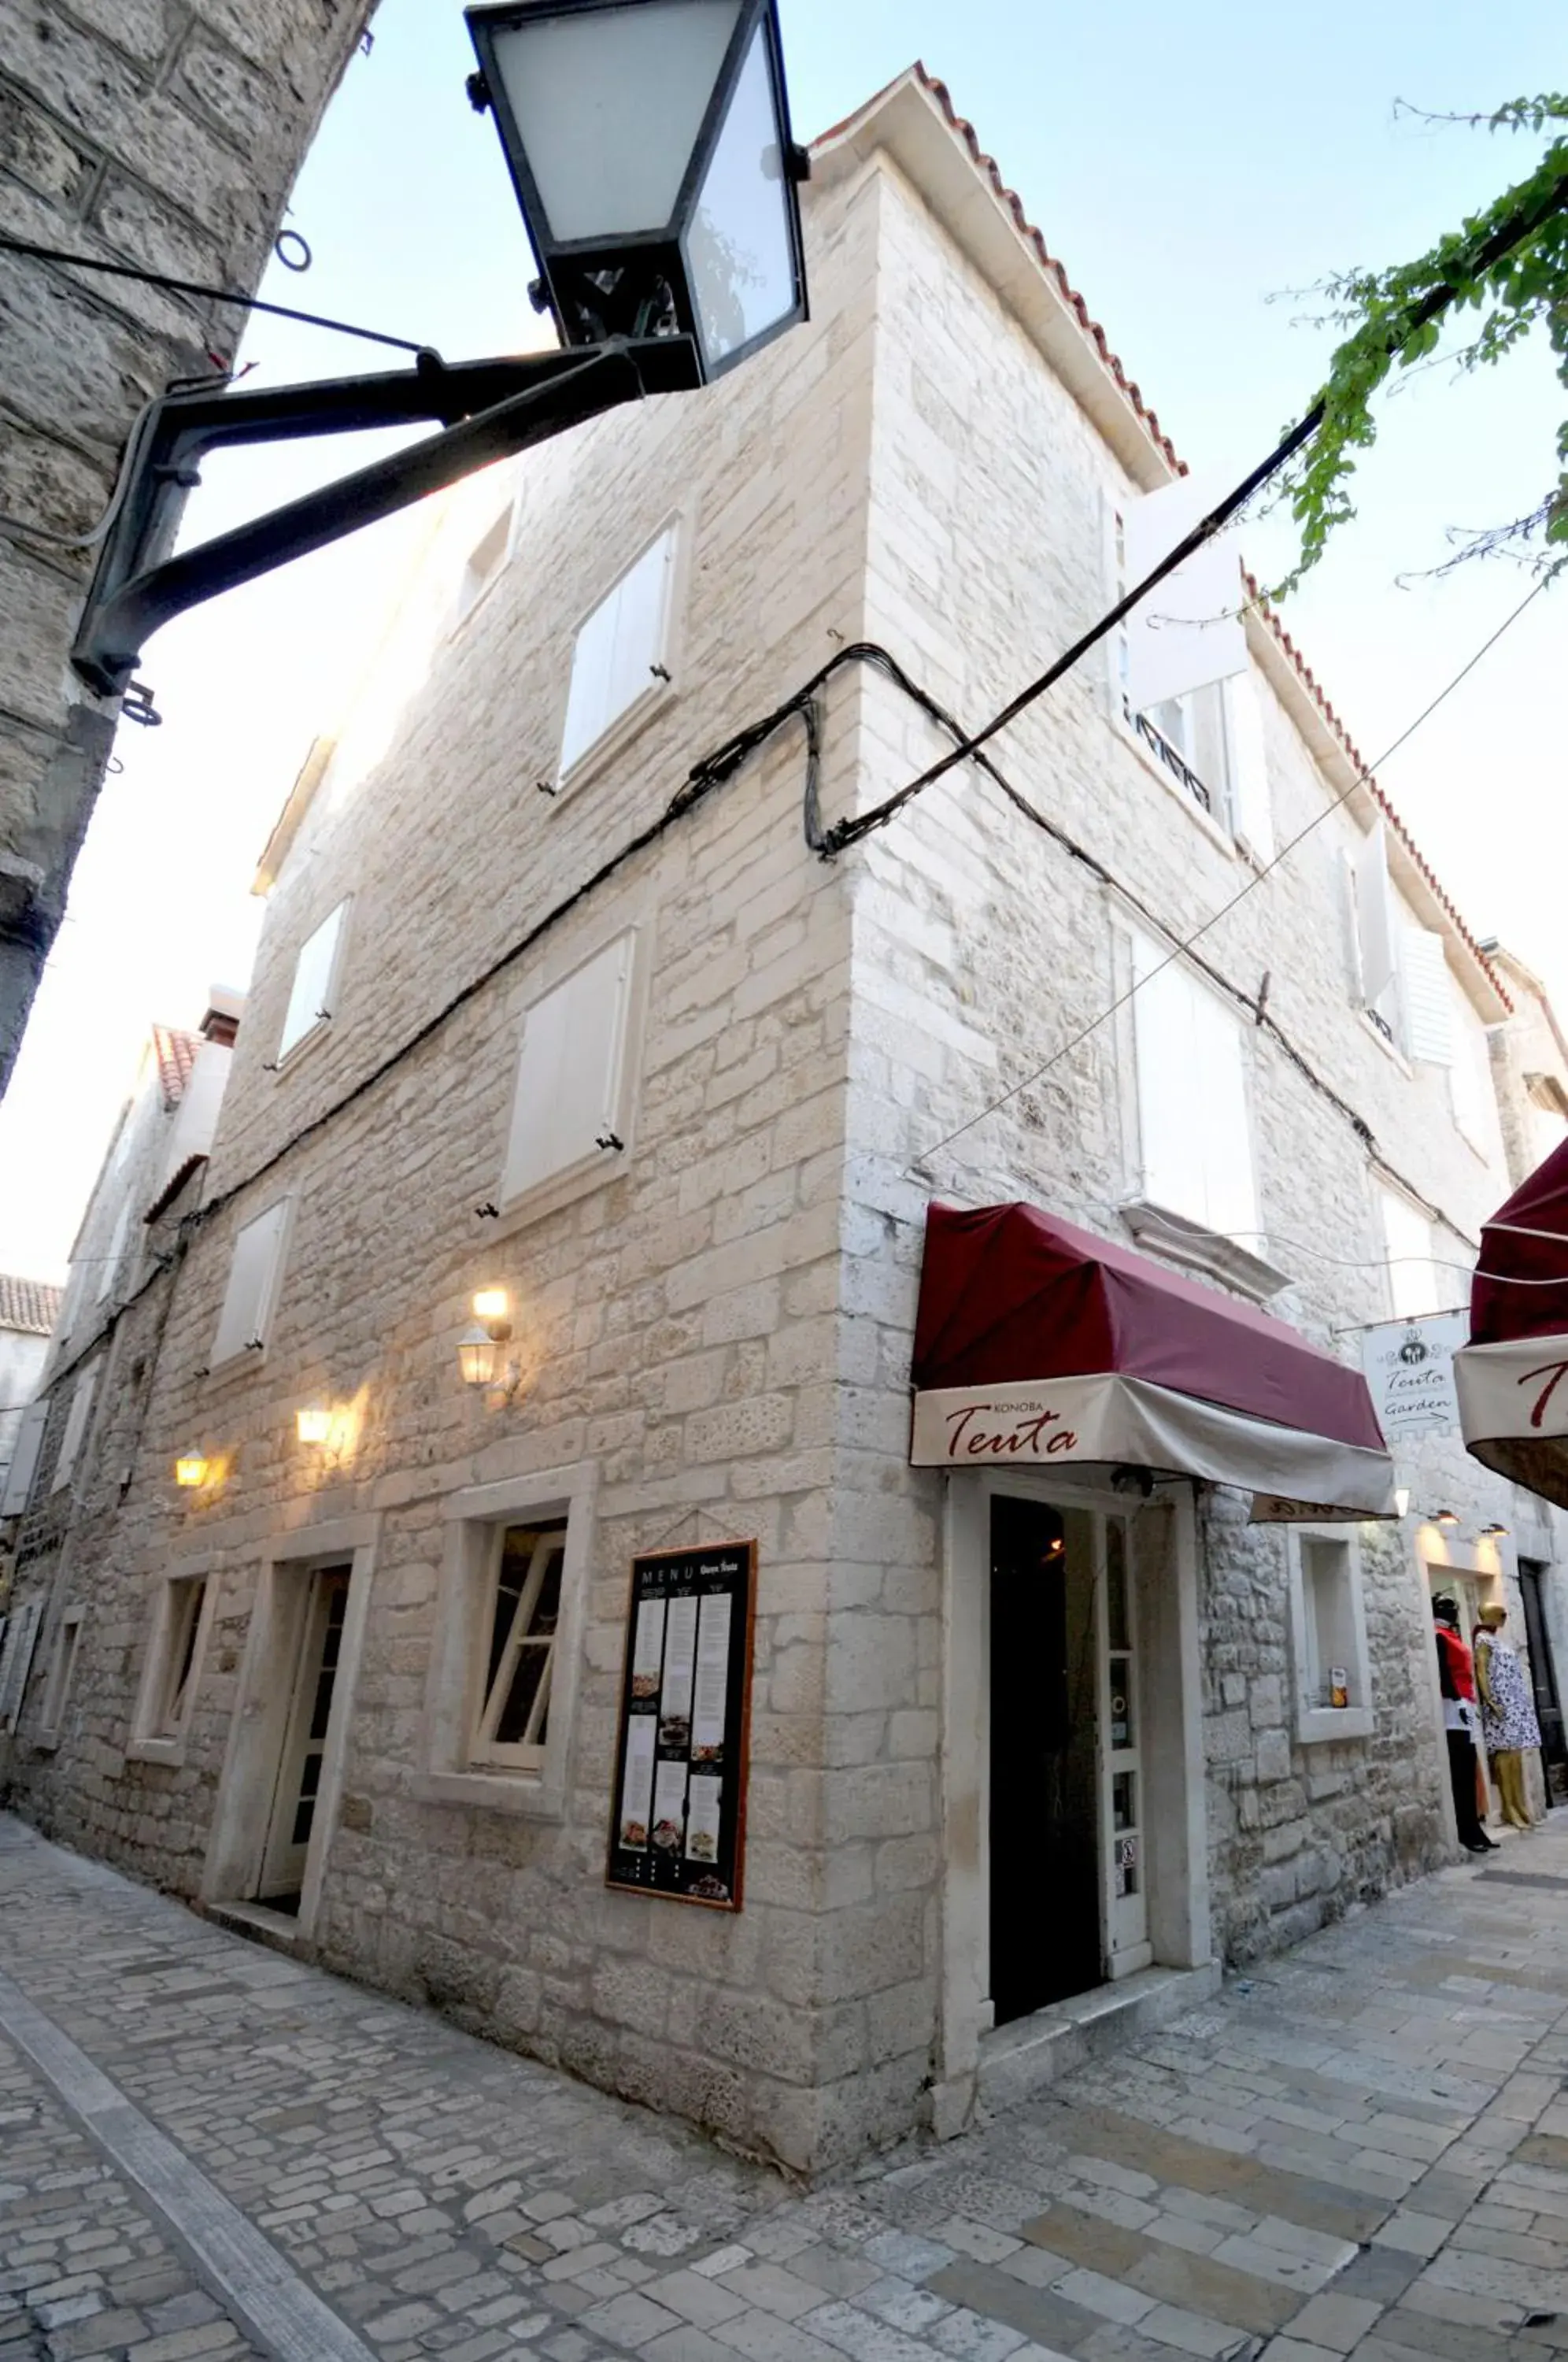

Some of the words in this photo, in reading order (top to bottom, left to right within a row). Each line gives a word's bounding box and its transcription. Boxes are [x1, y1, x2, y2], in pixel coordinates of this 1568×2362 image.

[993, 1401, 1044, 1413] KONOBA
[1385, 1399, 1452, 1415] Garden
[945, 1405, 1078, 1457] Teuta
[642, 1566, 693, 1584] MENU
